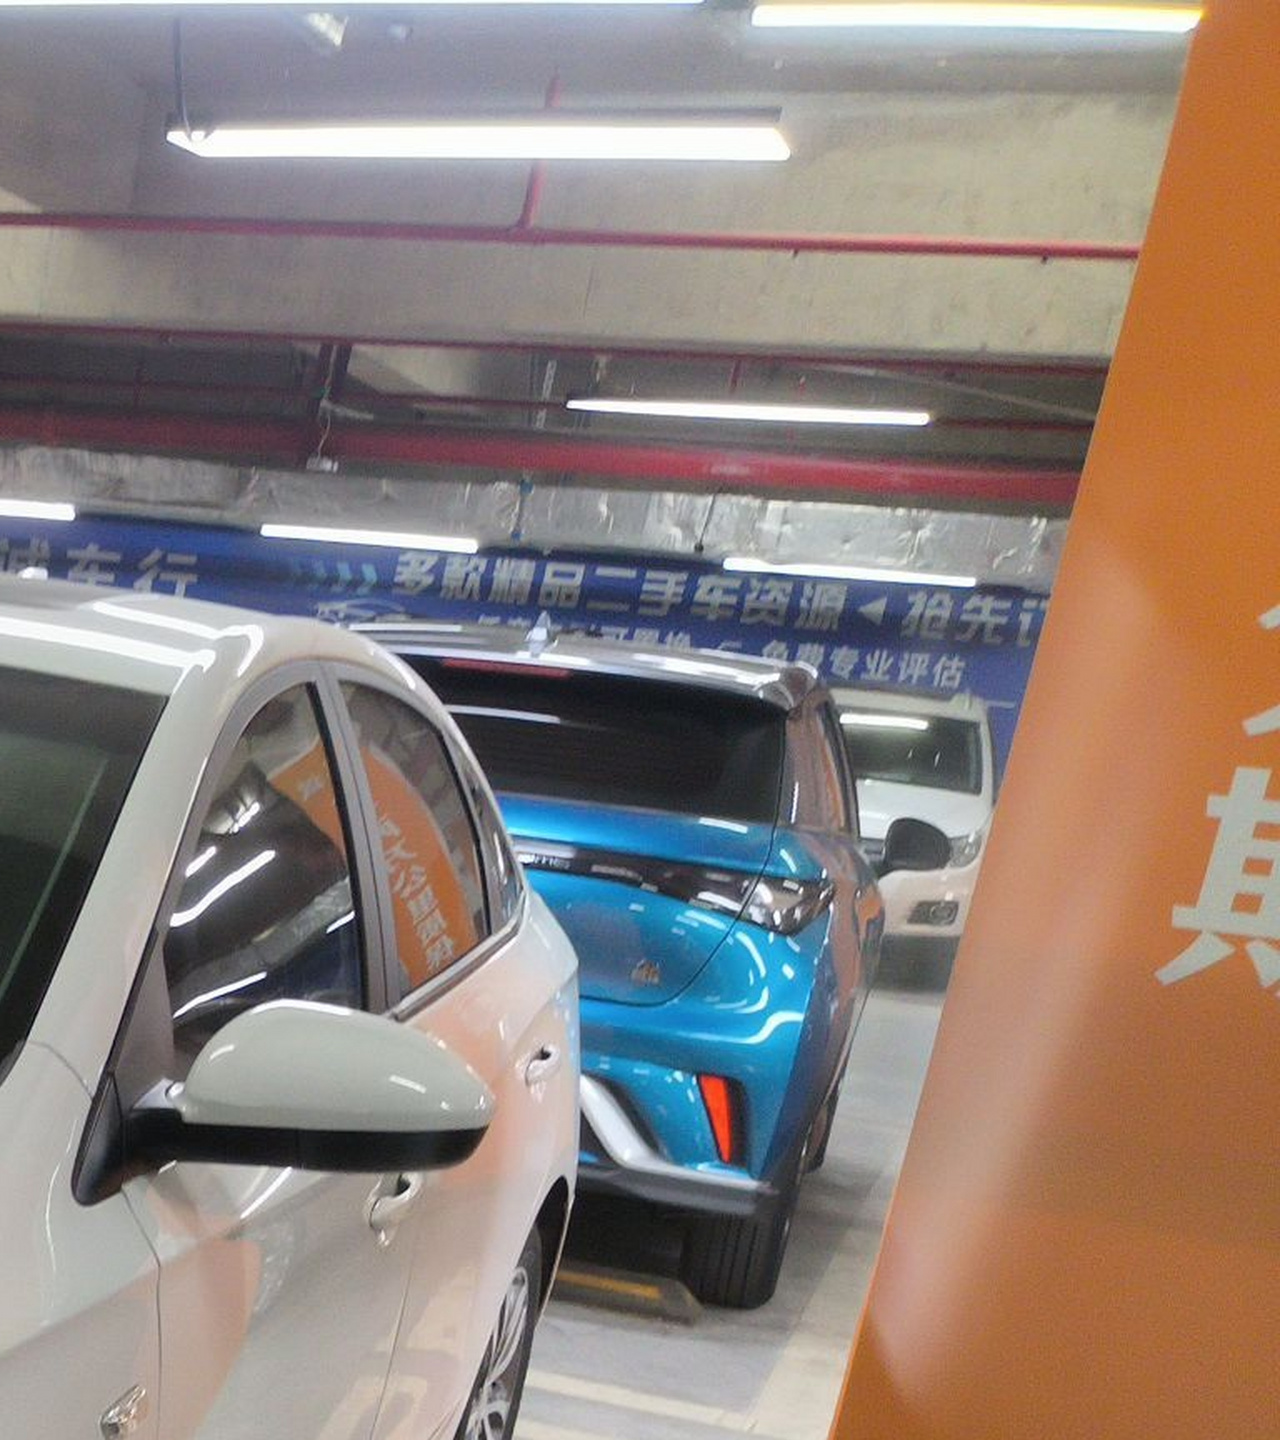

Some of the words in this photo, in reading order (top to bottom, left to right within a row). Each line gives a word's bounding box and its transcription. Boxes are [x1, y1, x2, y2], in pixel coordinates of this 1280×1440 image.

[392, 551, 849, 632] 多款精品二手车资源
